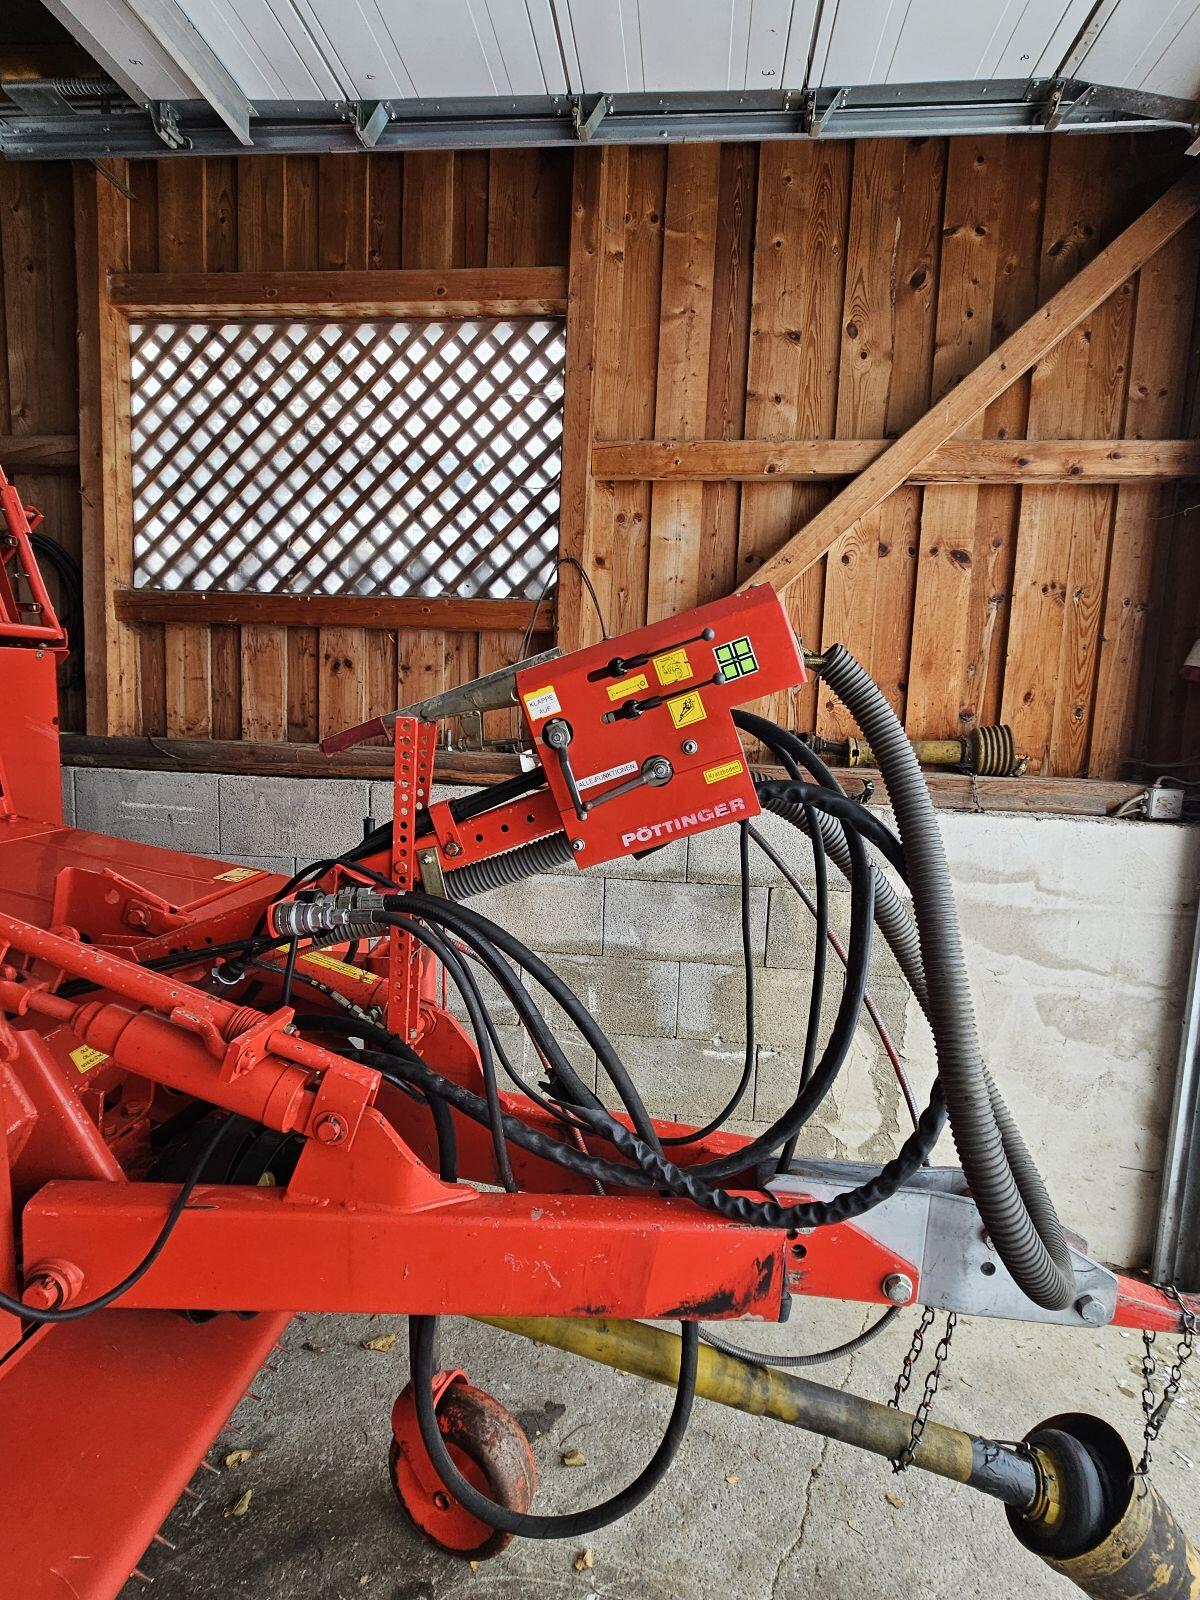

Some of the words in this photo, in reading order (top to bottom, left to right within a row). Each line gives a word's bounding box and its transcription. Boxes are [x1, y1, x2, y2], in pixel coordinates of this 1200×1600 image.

[529, 694, 553, 707] KLAPPE
[539, 705, 551, 714] AUF
[621, 797, 746, 848] PÖTTINGER
